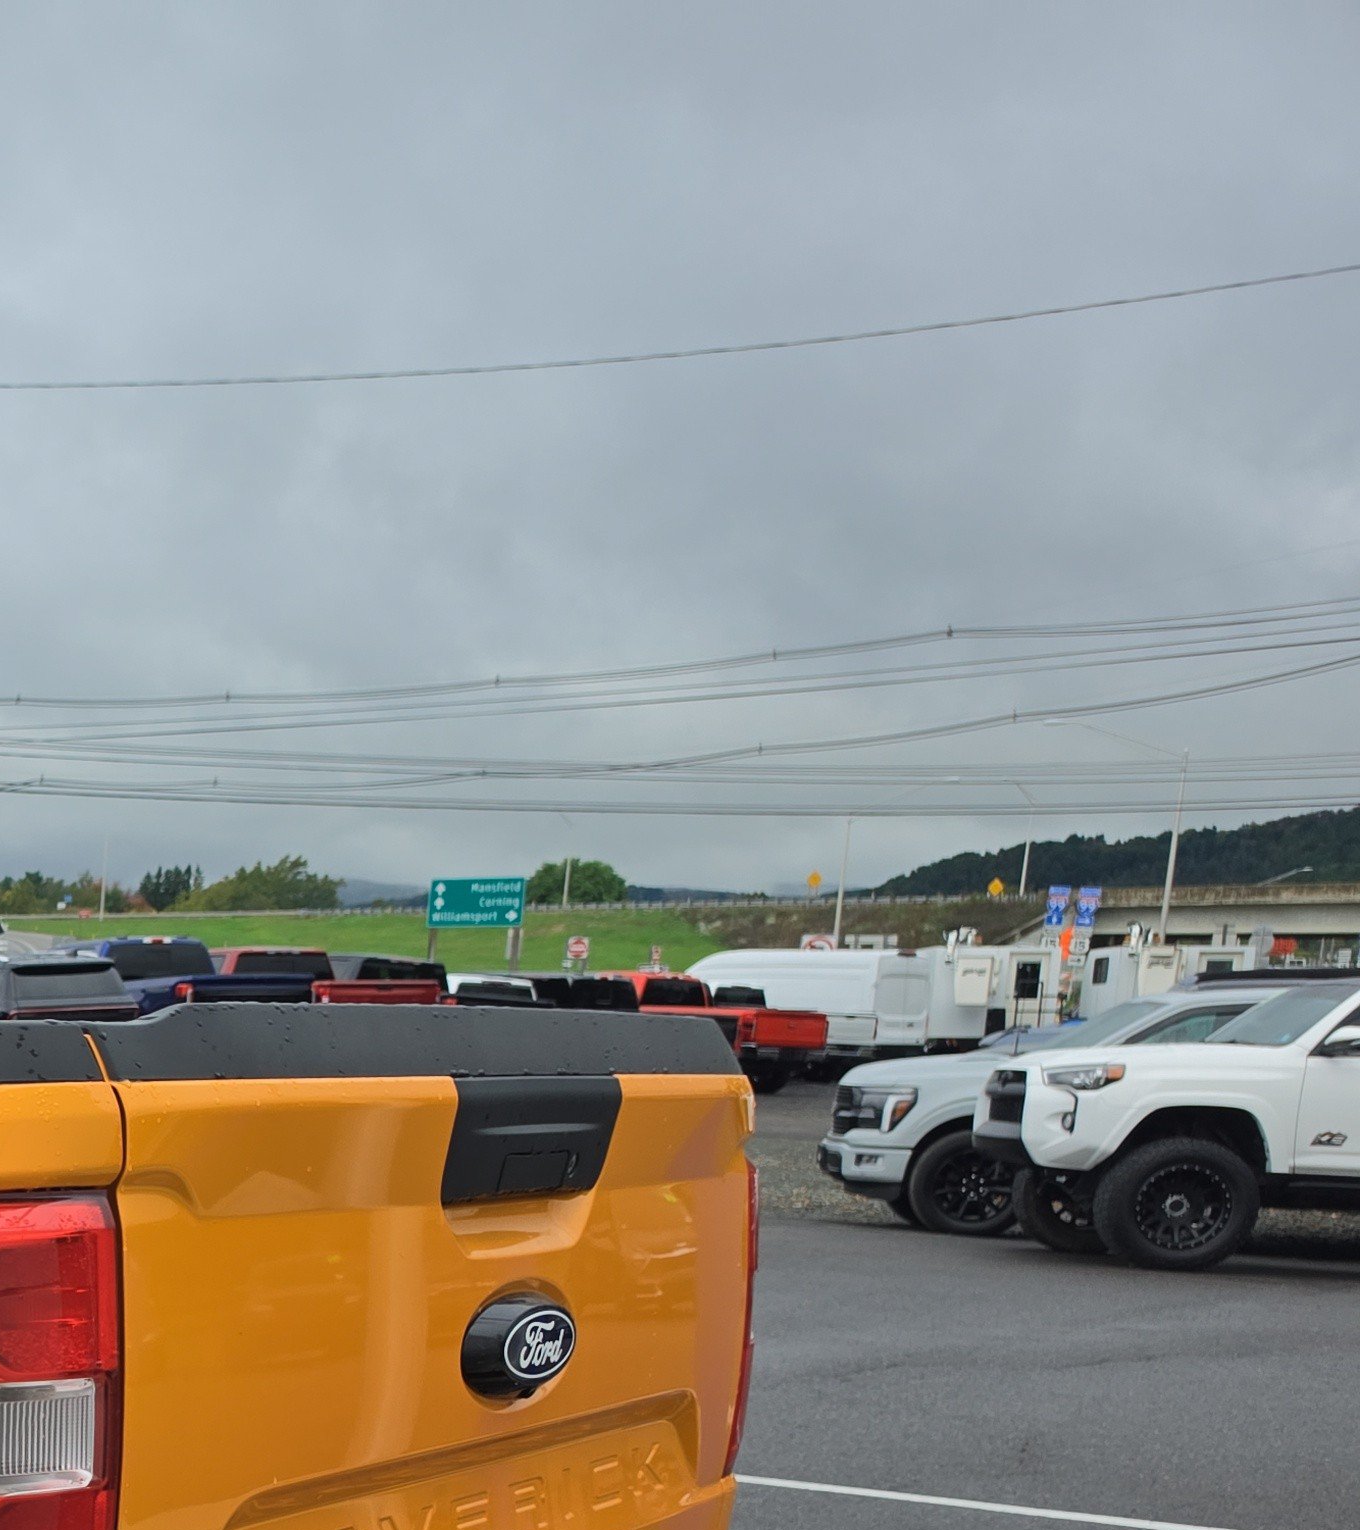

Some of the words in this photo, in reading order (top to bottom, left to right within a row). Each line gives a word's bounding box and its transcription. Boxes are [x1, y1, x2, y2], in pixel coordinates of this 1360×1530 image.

[470, 881, 521, 894] Mansfield
[479, 896, 520, 910] Corning
[431, 911, 498, 924] Williamsport
[520, 1320, 564, 1369] Ford
